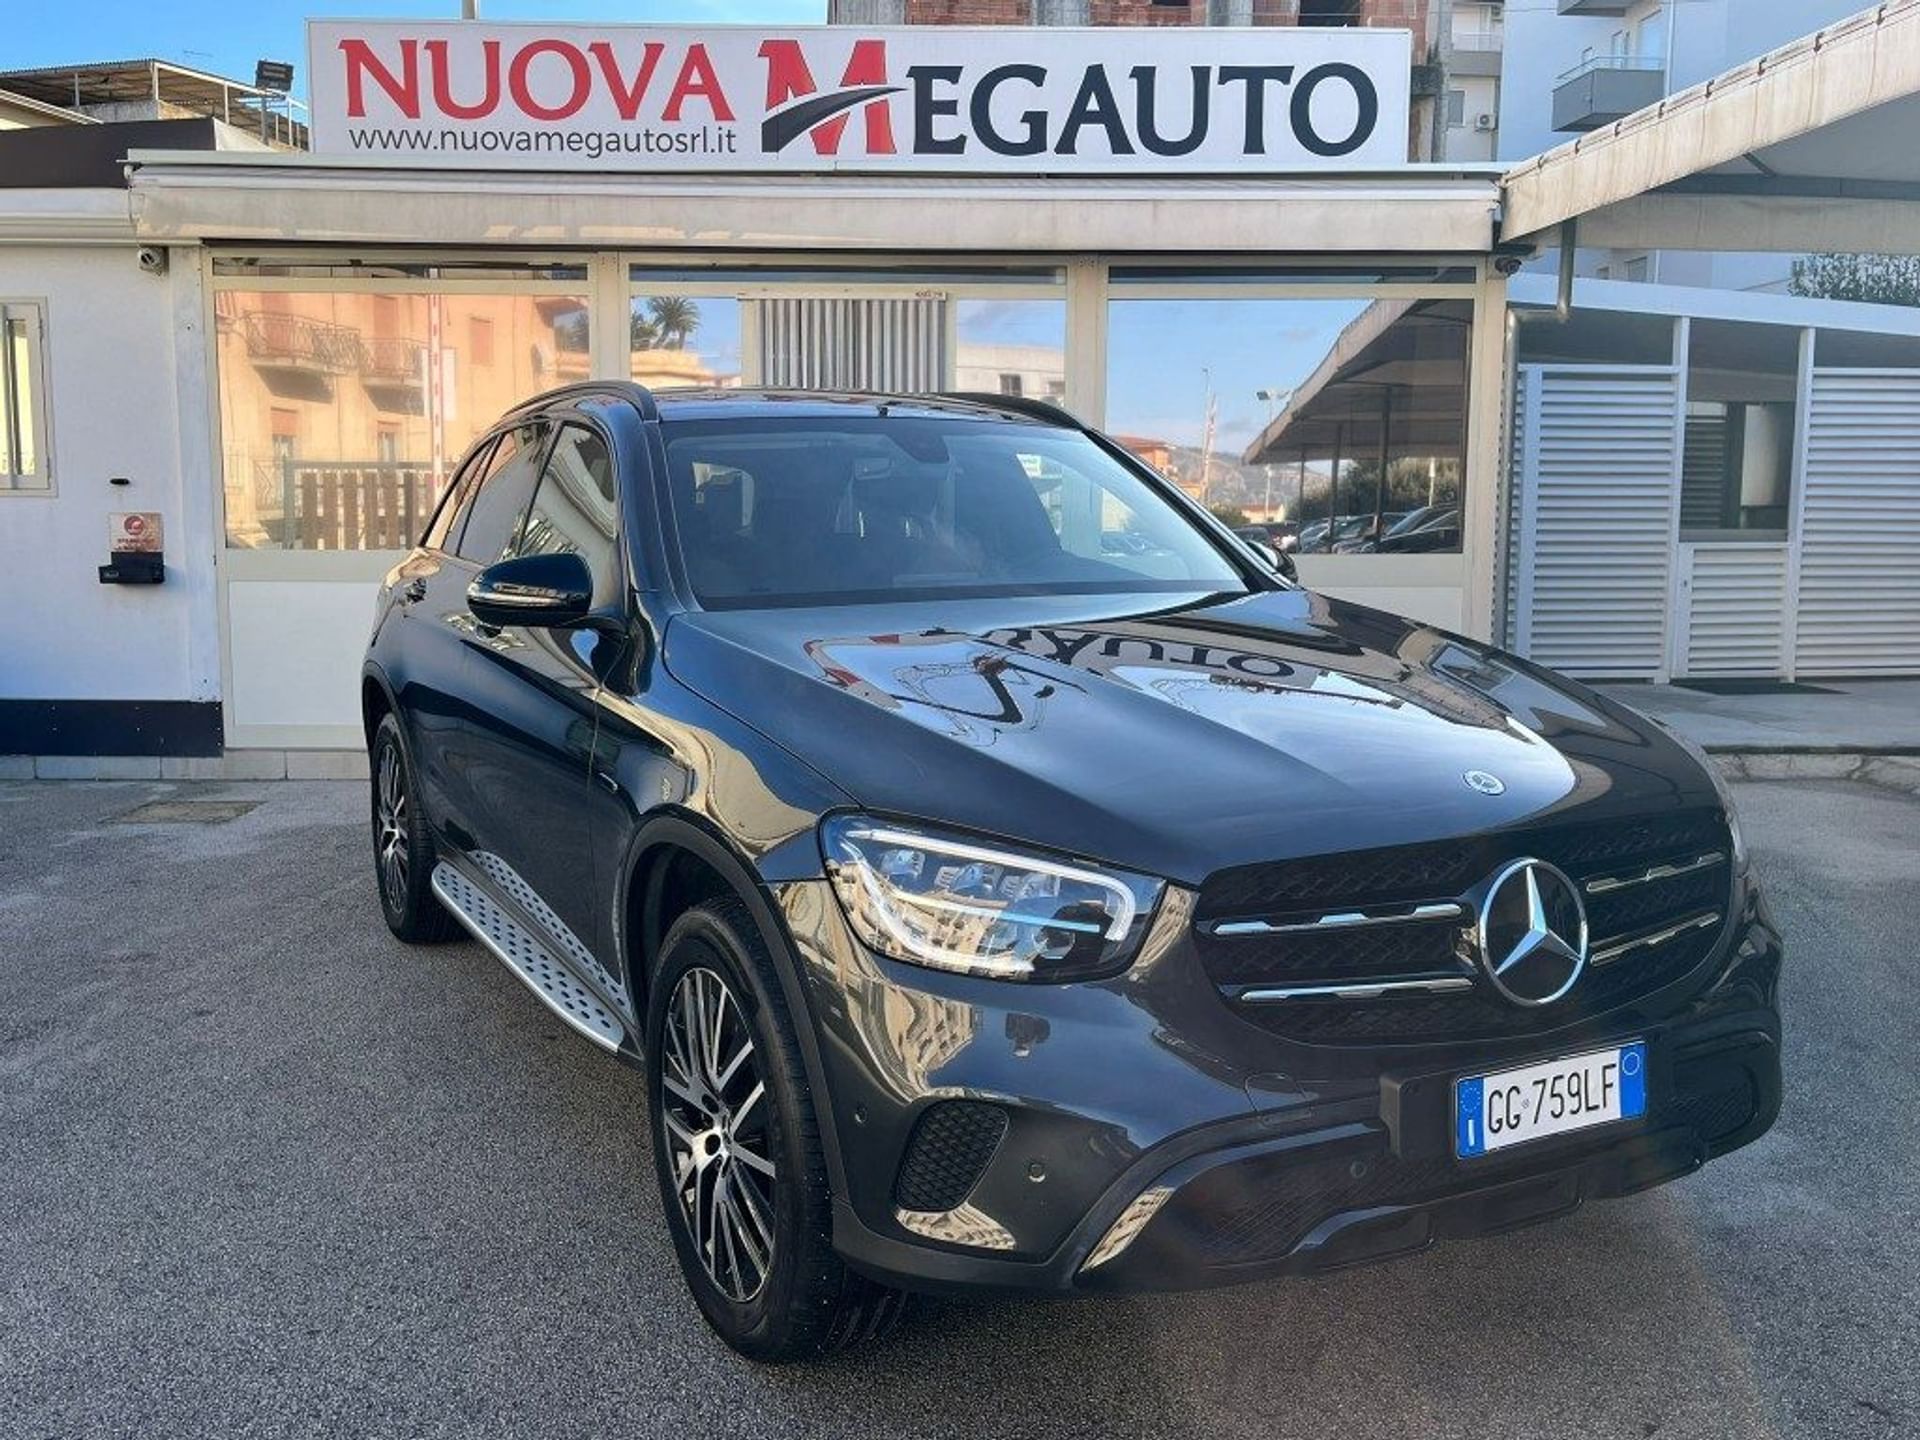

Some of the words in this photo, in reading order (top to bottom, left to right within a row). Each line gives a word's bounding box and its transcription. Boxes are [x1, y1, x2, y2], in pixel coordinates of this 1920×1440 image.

[338, 39, 736, 121] NUOVA
[758, 39, 1379, 157] MEGAUTO
[349, 126, 737, 158] www.nuovamegautosrl.it
[1488, 1085, 1521, 1134] GG
[1532, 1063, 1617, 1125] 759LF
